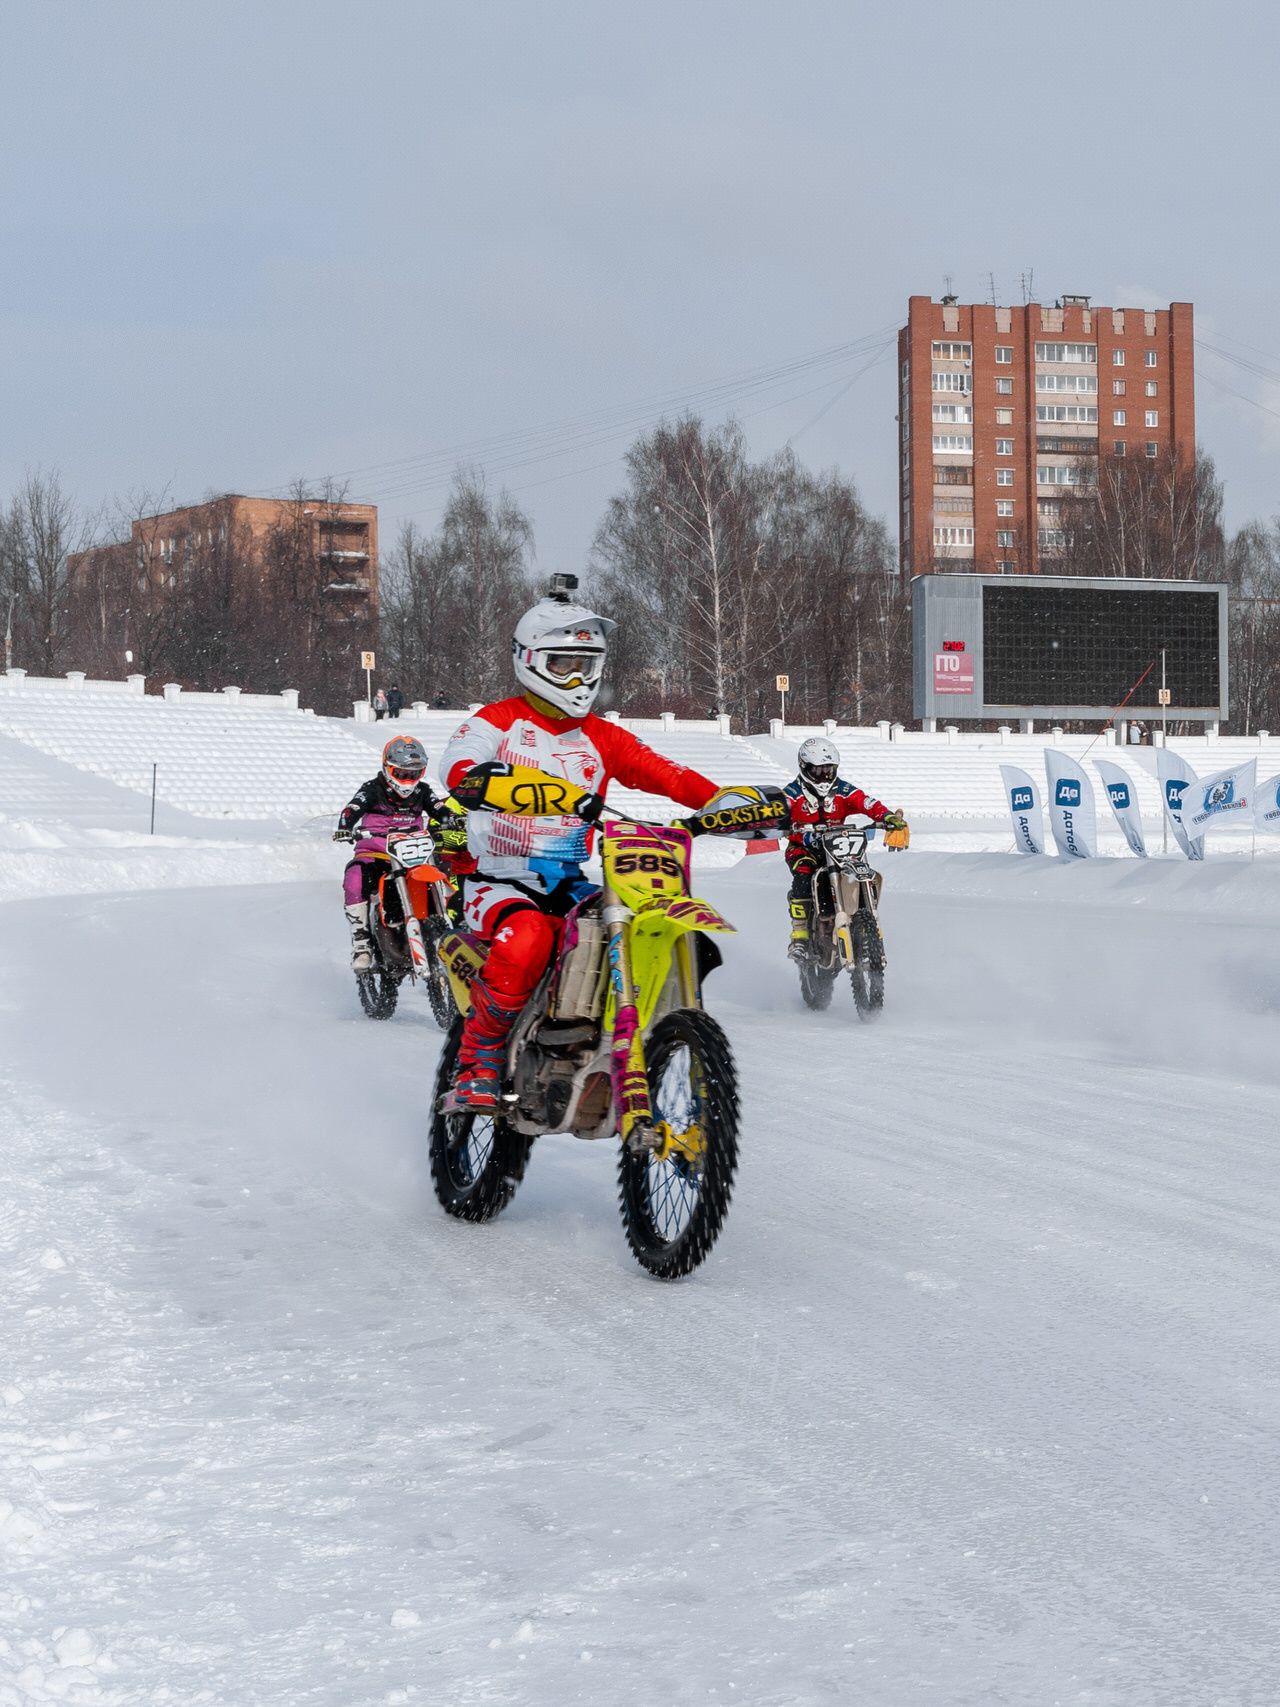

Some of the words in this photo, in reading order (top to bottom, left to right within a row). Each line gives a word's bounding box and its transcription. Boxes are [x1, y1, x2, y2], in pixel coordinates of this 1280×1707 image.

[366, 653, 372, 663] 9
[935, 654, 960, 672] ГТО
[779, 676, 788, 685] 10
[1014, 793, 1032, 805] Да
[1059, 786, 1079, 799] Да
[1110, 790, 1126, 802] Да
[701, 802, 786, 829] OCKSTAR
[394, 838, 432, 860] 152
[832, 836, 864, 857] 37
[614, 854, 680, 878] 585
